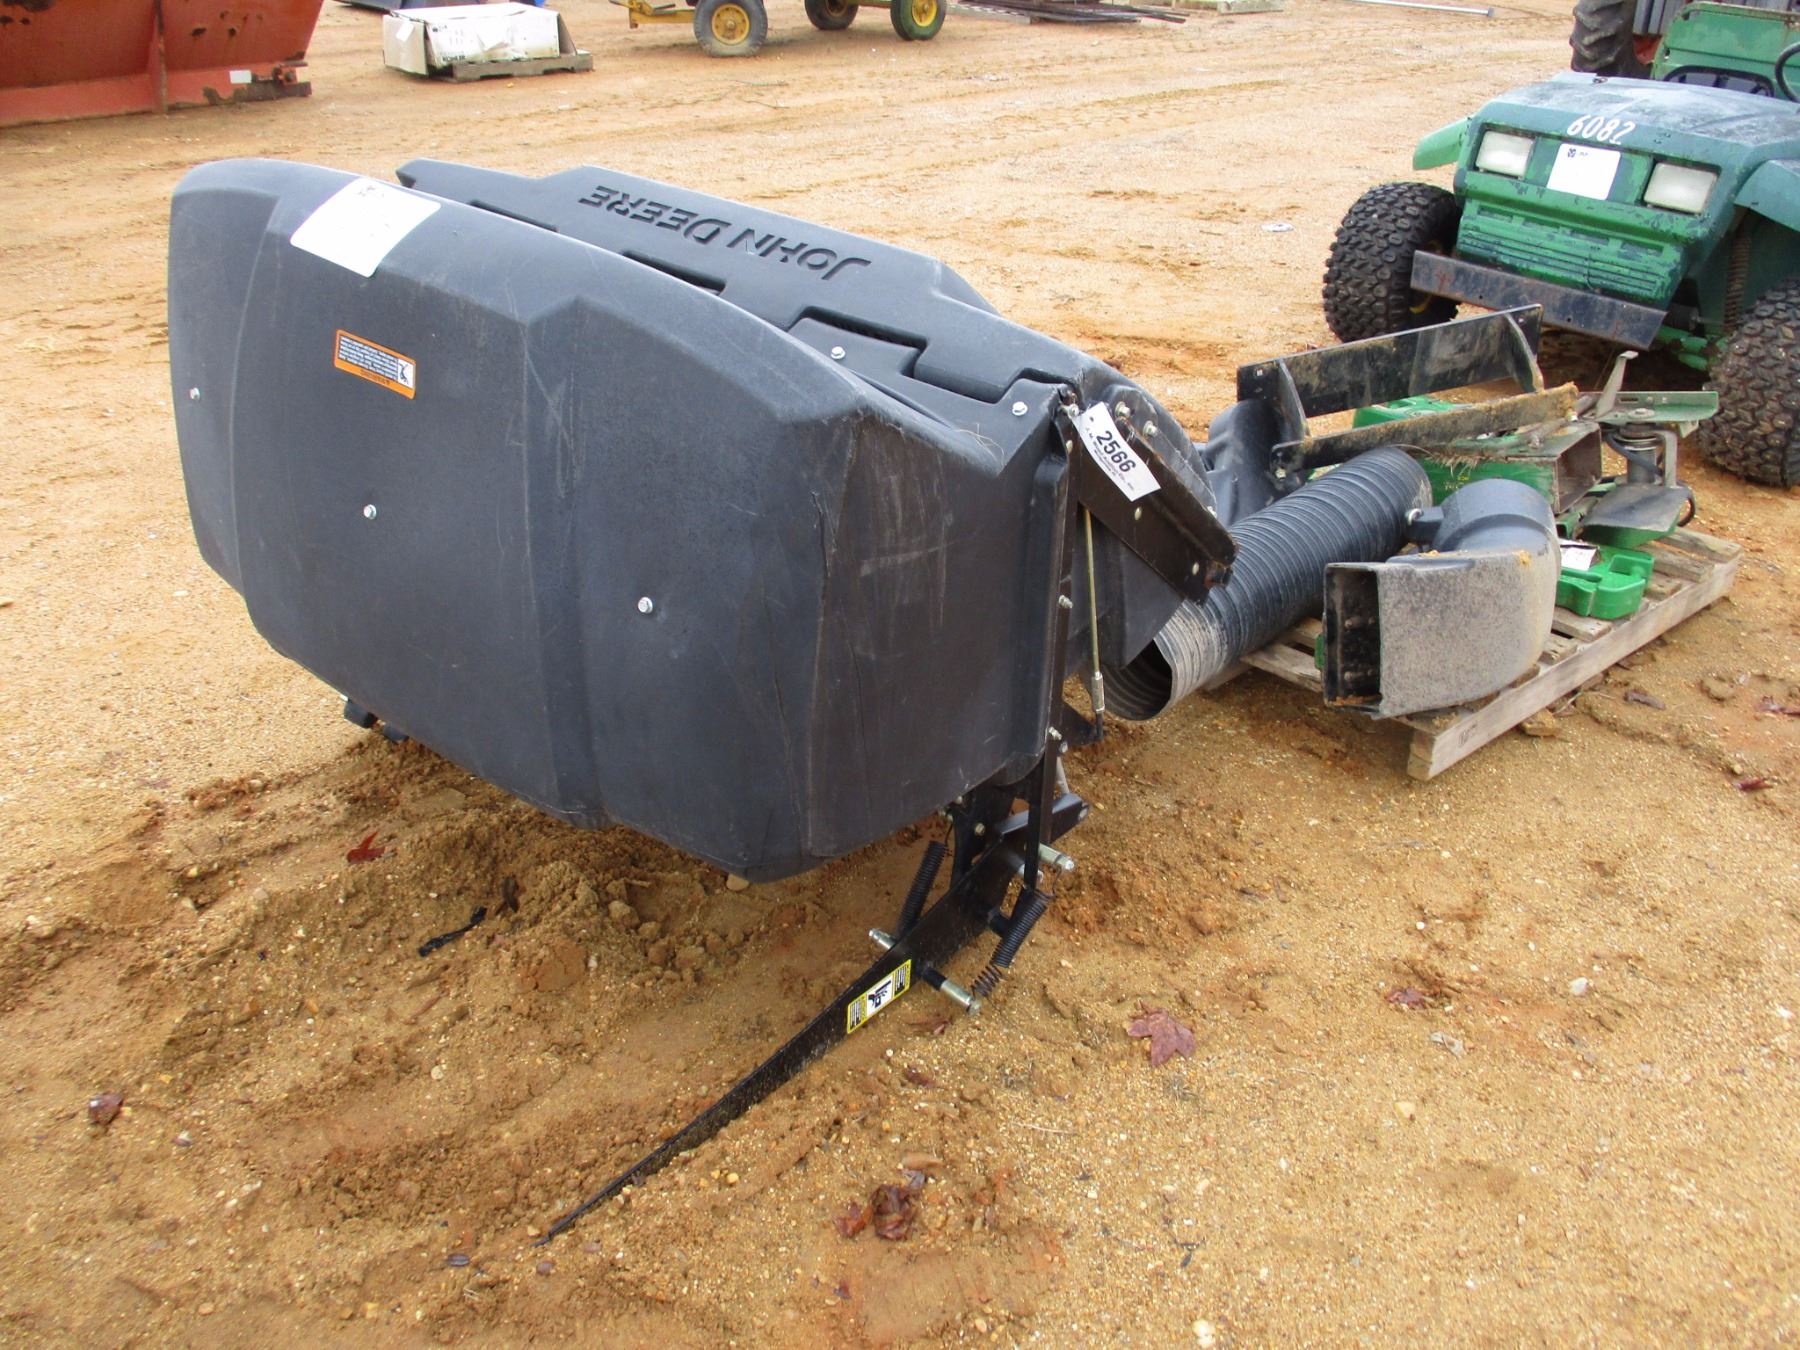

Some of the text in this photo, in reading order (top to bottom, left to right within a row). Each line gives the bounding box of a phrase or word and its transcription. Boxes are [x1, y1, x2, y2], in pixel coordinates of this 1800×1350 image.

[1567, 115, 1636, 145] 6082
[578, 185, 872, 281] JOHN DEERE
[1096, 430, 1136, 472] 2566
